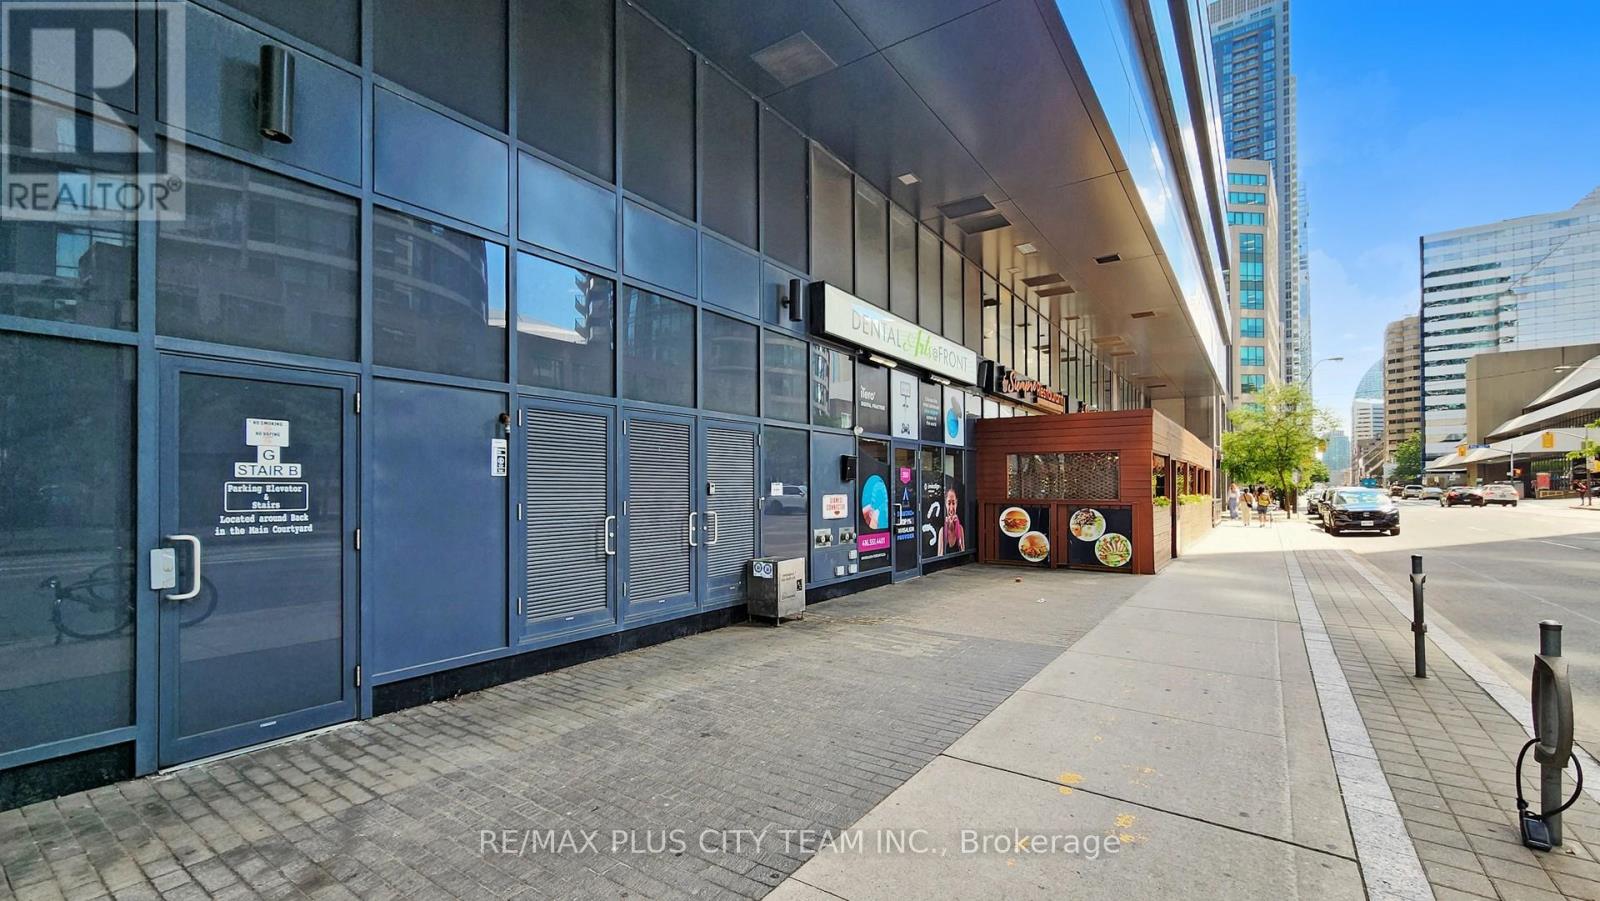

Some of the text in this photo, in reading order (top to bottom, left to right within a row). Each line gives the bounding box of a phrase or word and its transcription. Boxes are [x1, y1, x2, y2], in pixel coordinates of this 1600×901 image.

[851, 309, 901, 349] DENTAL
[262, 449, 276, 461] G
[237, 464, 299, 476] STAIR B
[227, 484, 303, 495] Parking Elevator
[263, 493, 270, 501] &
[251, 501, 281, 509] Stairs
[219, 512, 309, 524] Located around Back
[214, 523, 313, 536] in the Main Courtyard
